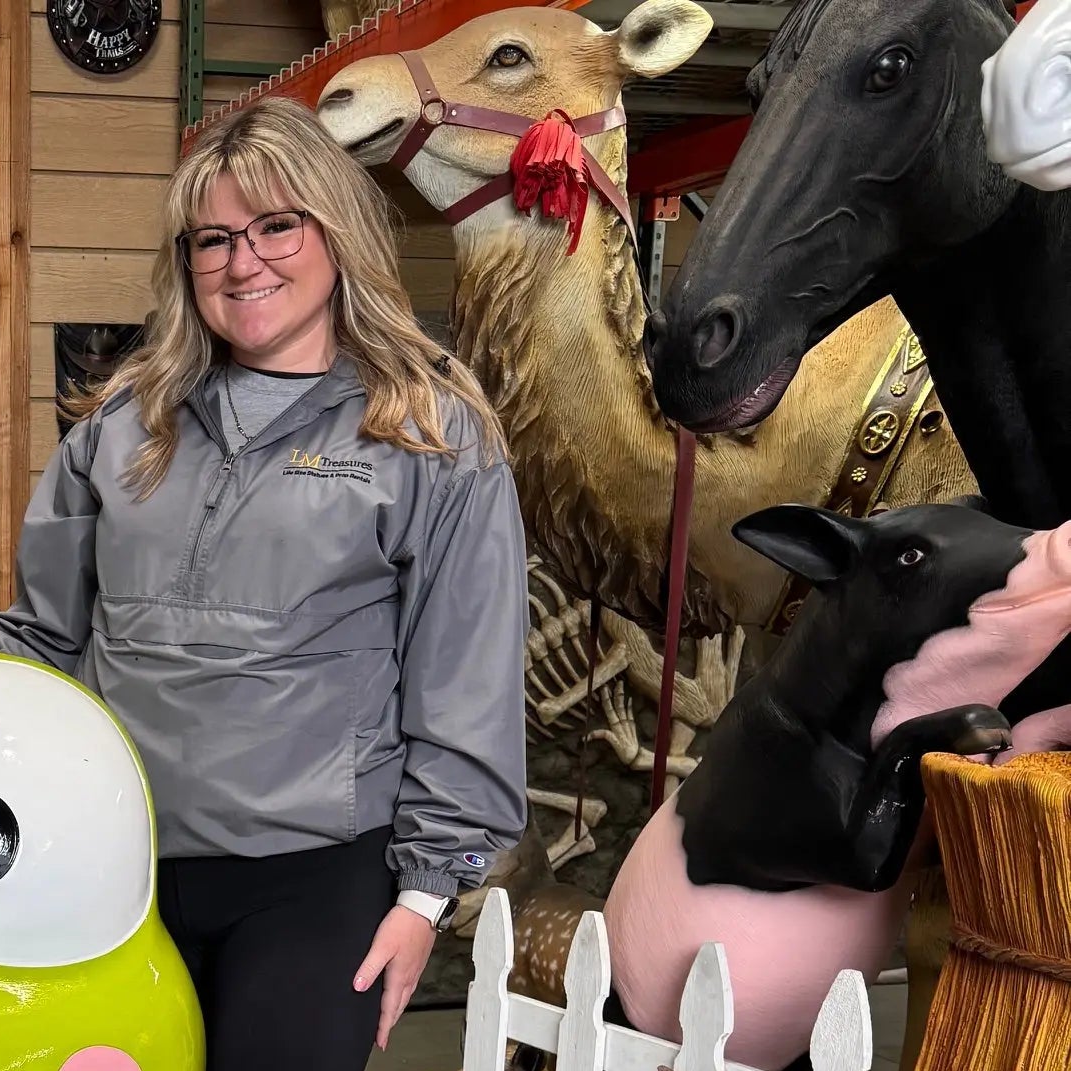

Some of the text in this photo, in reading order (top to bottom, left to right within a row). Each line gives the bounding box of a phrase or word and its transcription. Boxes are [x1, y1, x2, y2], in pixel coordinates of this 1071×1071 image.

[86, 28, 131, 49] HAPPY
[94, 46, 124, 58] TRAILS
[289, 448, 373, 471] LM Treasures
